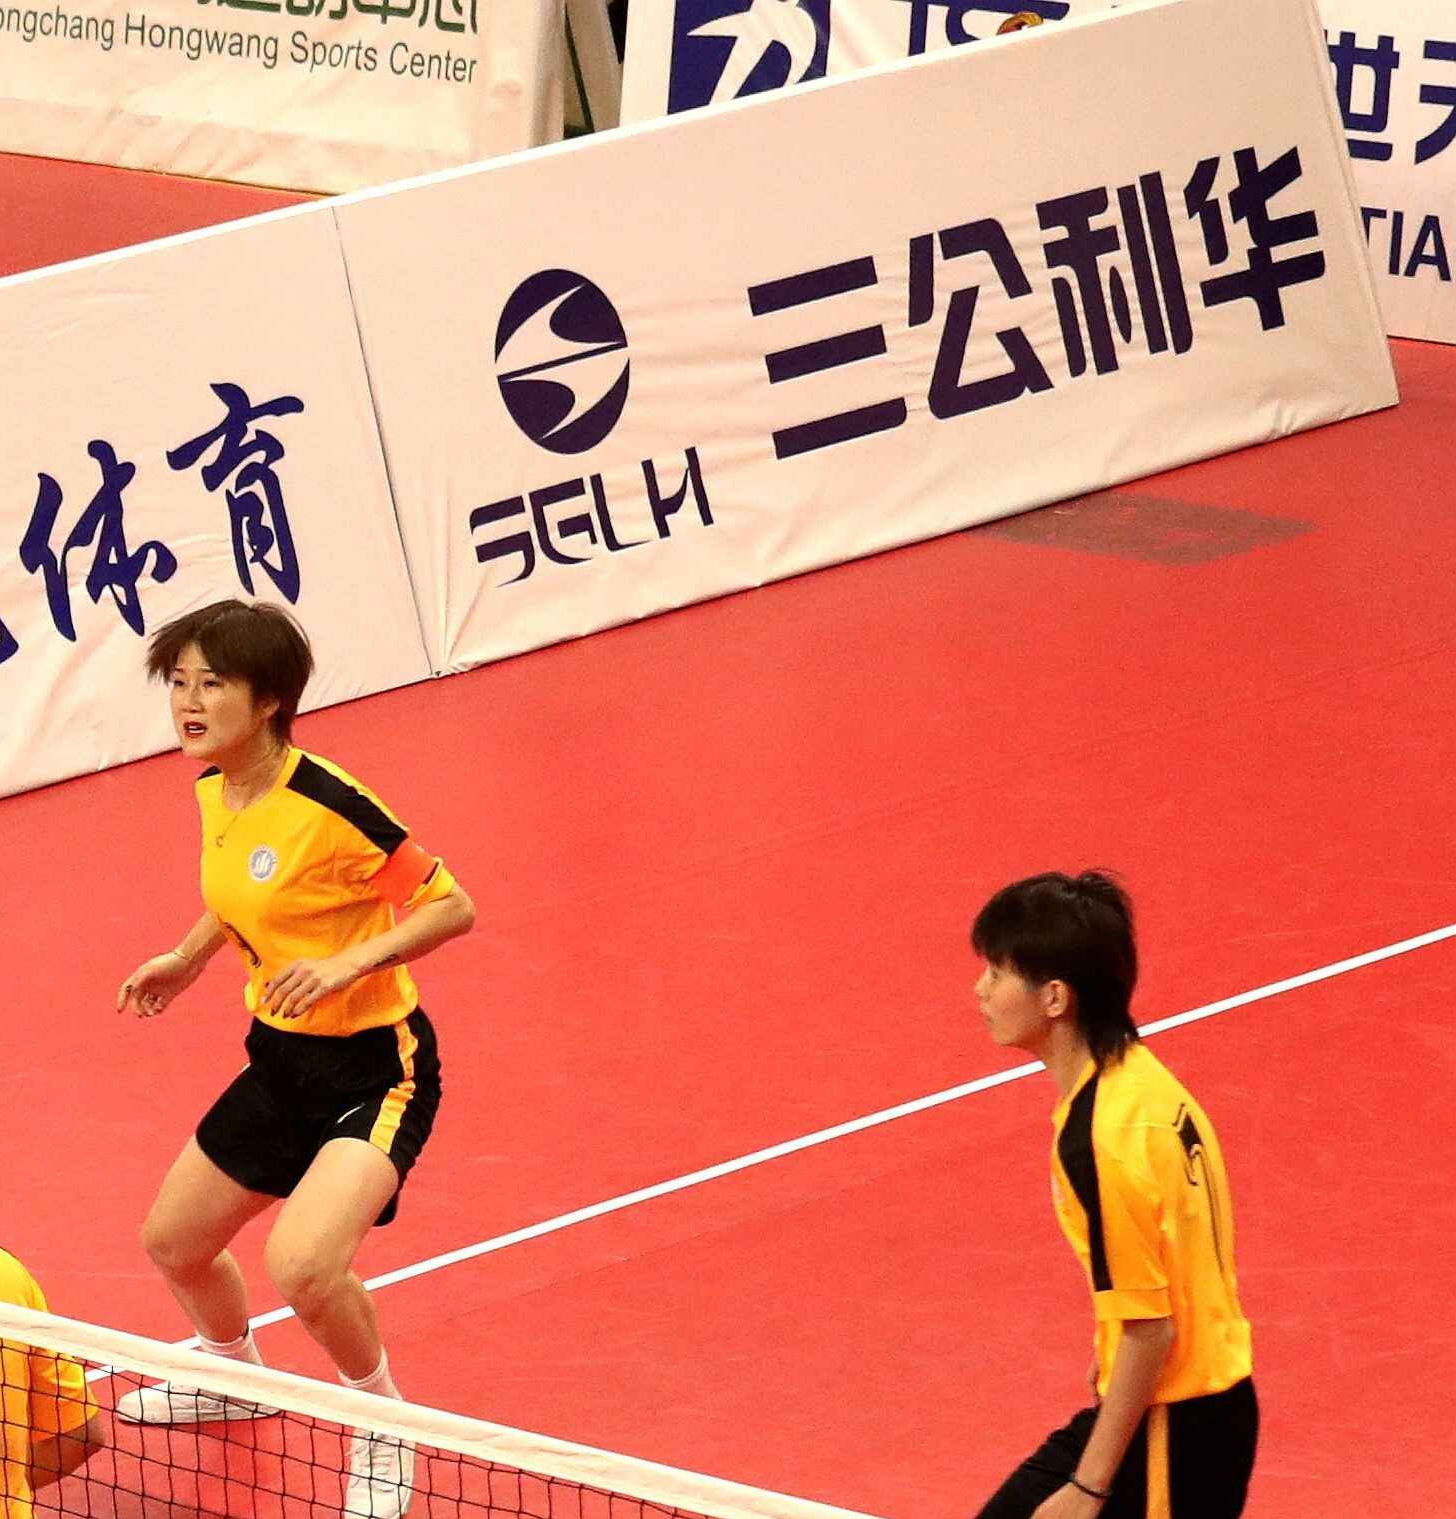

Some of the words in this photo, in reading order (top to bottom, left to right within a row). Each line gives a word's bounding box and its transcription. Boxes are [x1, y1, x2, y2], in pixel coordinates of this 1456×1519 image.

[124, 14, 279, 68] Hongwang
[290, 31, 378, 72] Sports
[389, 42, 477, 84] Center
[746, 145, 1326, 461] 三公利华
